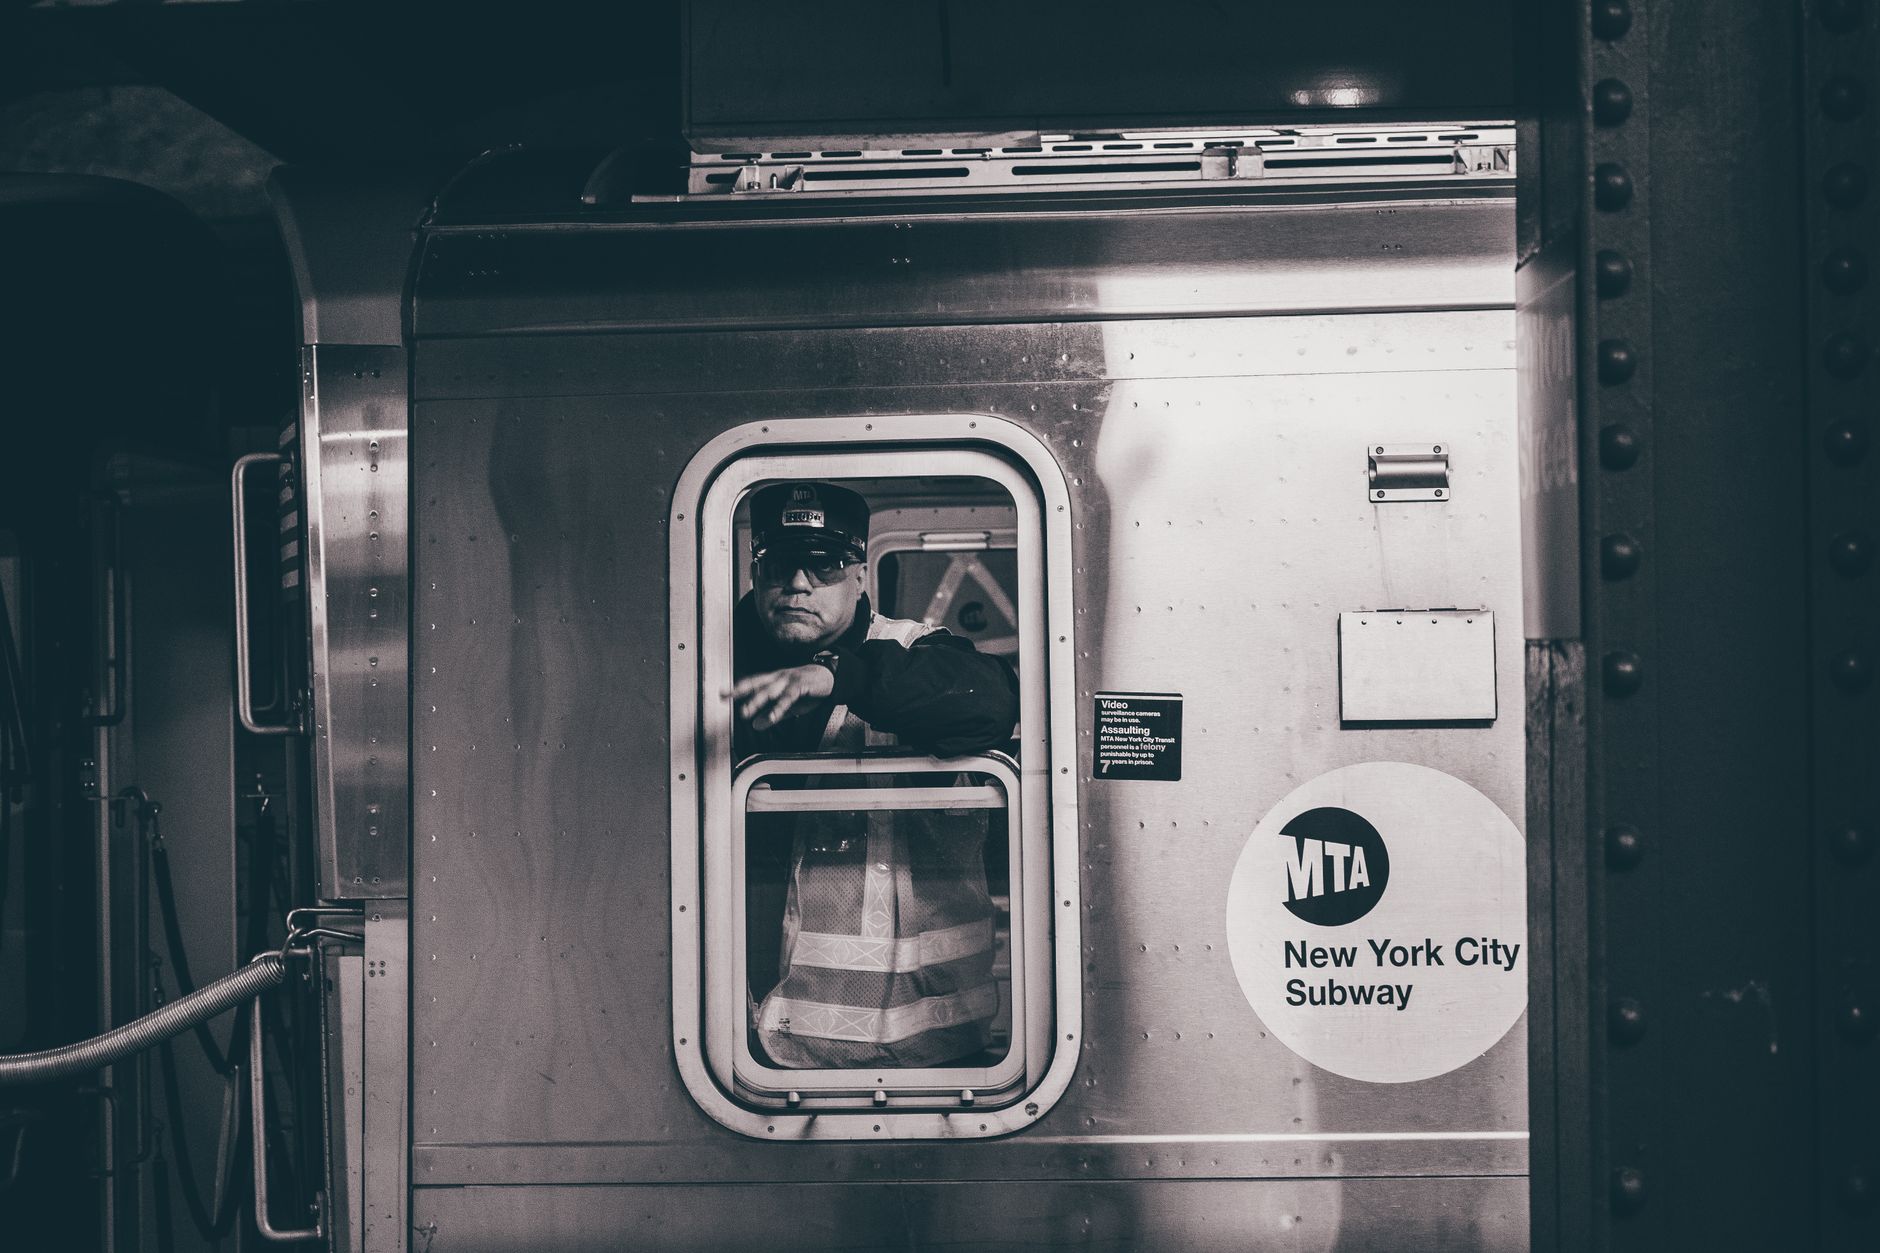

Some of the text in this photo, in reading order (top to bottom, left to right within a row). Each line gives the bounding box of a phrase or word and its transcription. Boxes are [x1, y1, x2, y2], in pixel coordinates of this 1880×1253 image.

[1101, 700, 1128, 709] Video
[1100, 725, 1150, 736] Assaulting
[1140, 742, 1166, 752] felony
[1100, 759, 1111, 774] 7
[1279, 833, 1370, 903] MTA
[1284, 937, 1520, 972] New York City
[1285, 978, 1413, 1011] Subway
